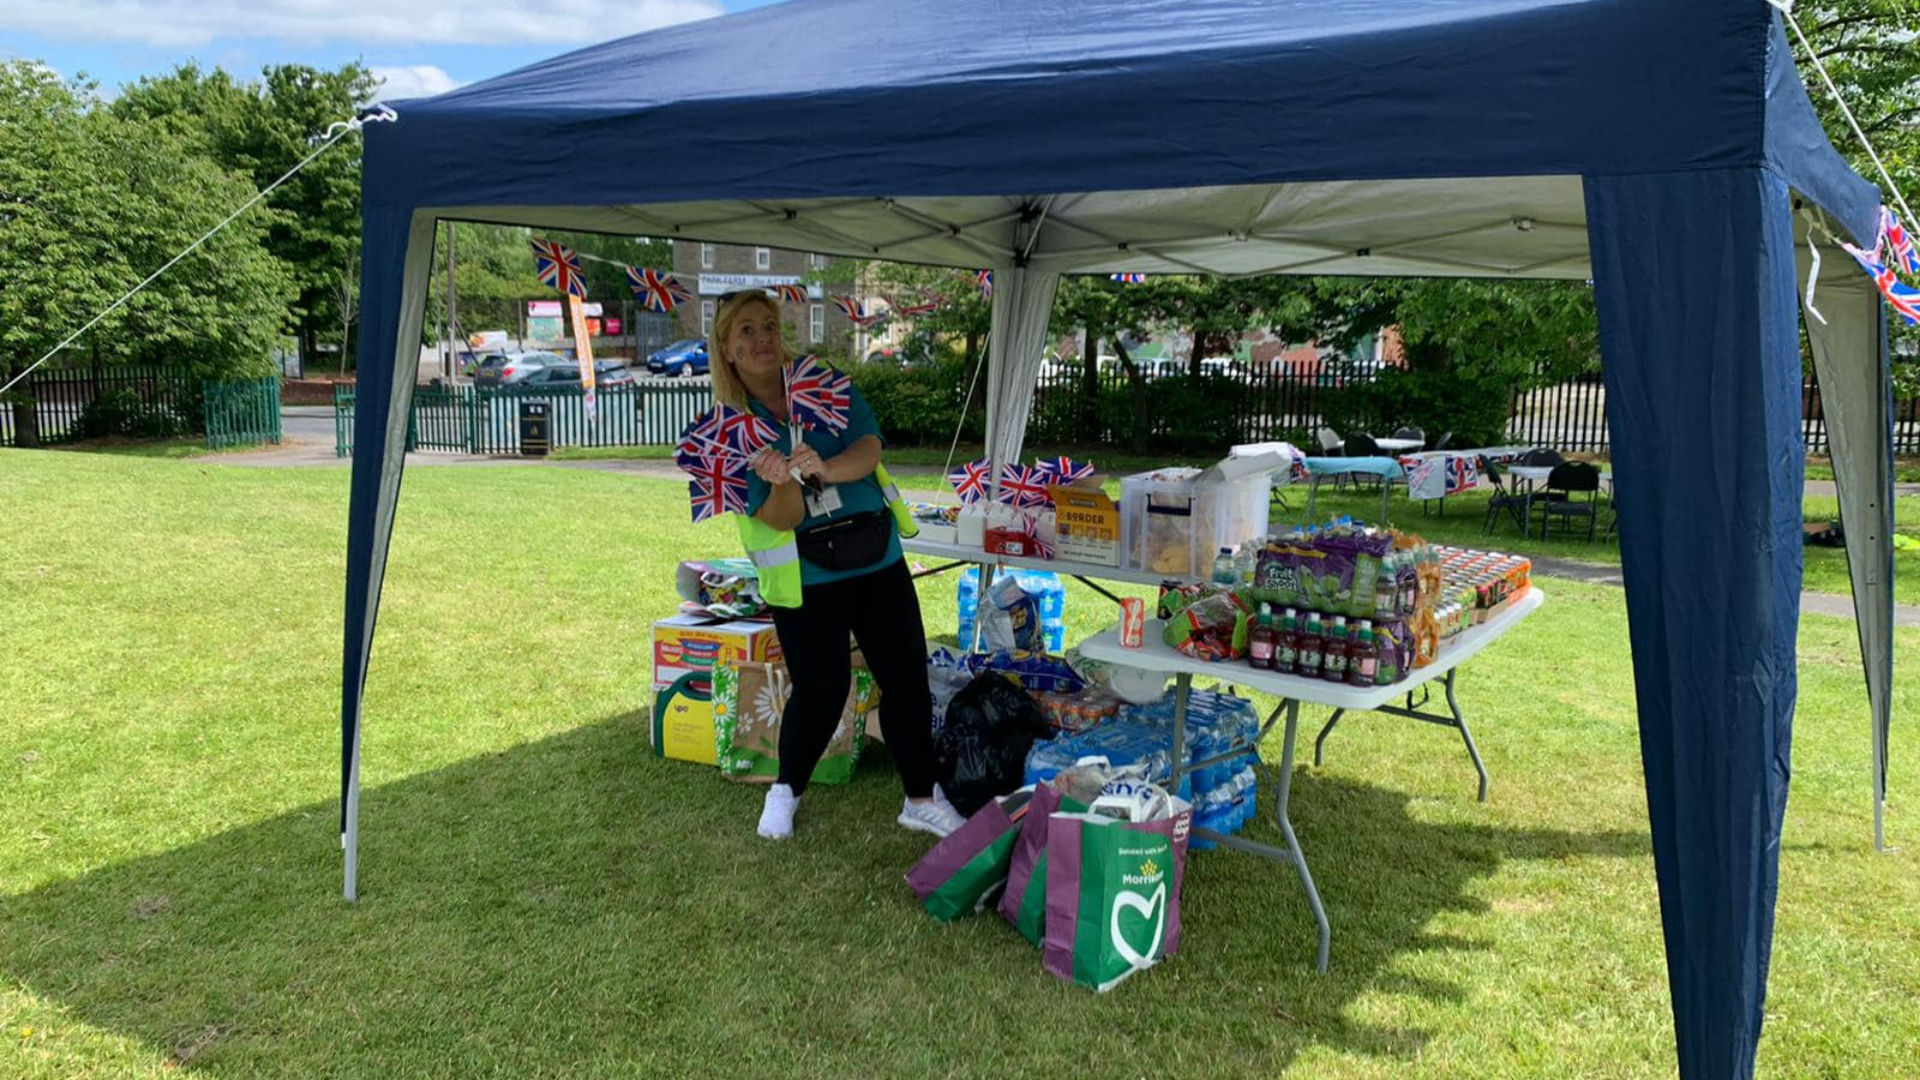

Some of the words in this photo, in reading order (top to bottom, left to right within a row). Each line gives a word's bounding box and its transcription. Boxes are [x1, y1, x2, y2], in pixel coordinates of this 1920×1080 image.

[1066, 511, 1105, 525] BORDER
[1269, 568, 1293, 579] Fruit
[1266, 578, 1297, 591] Shoot
